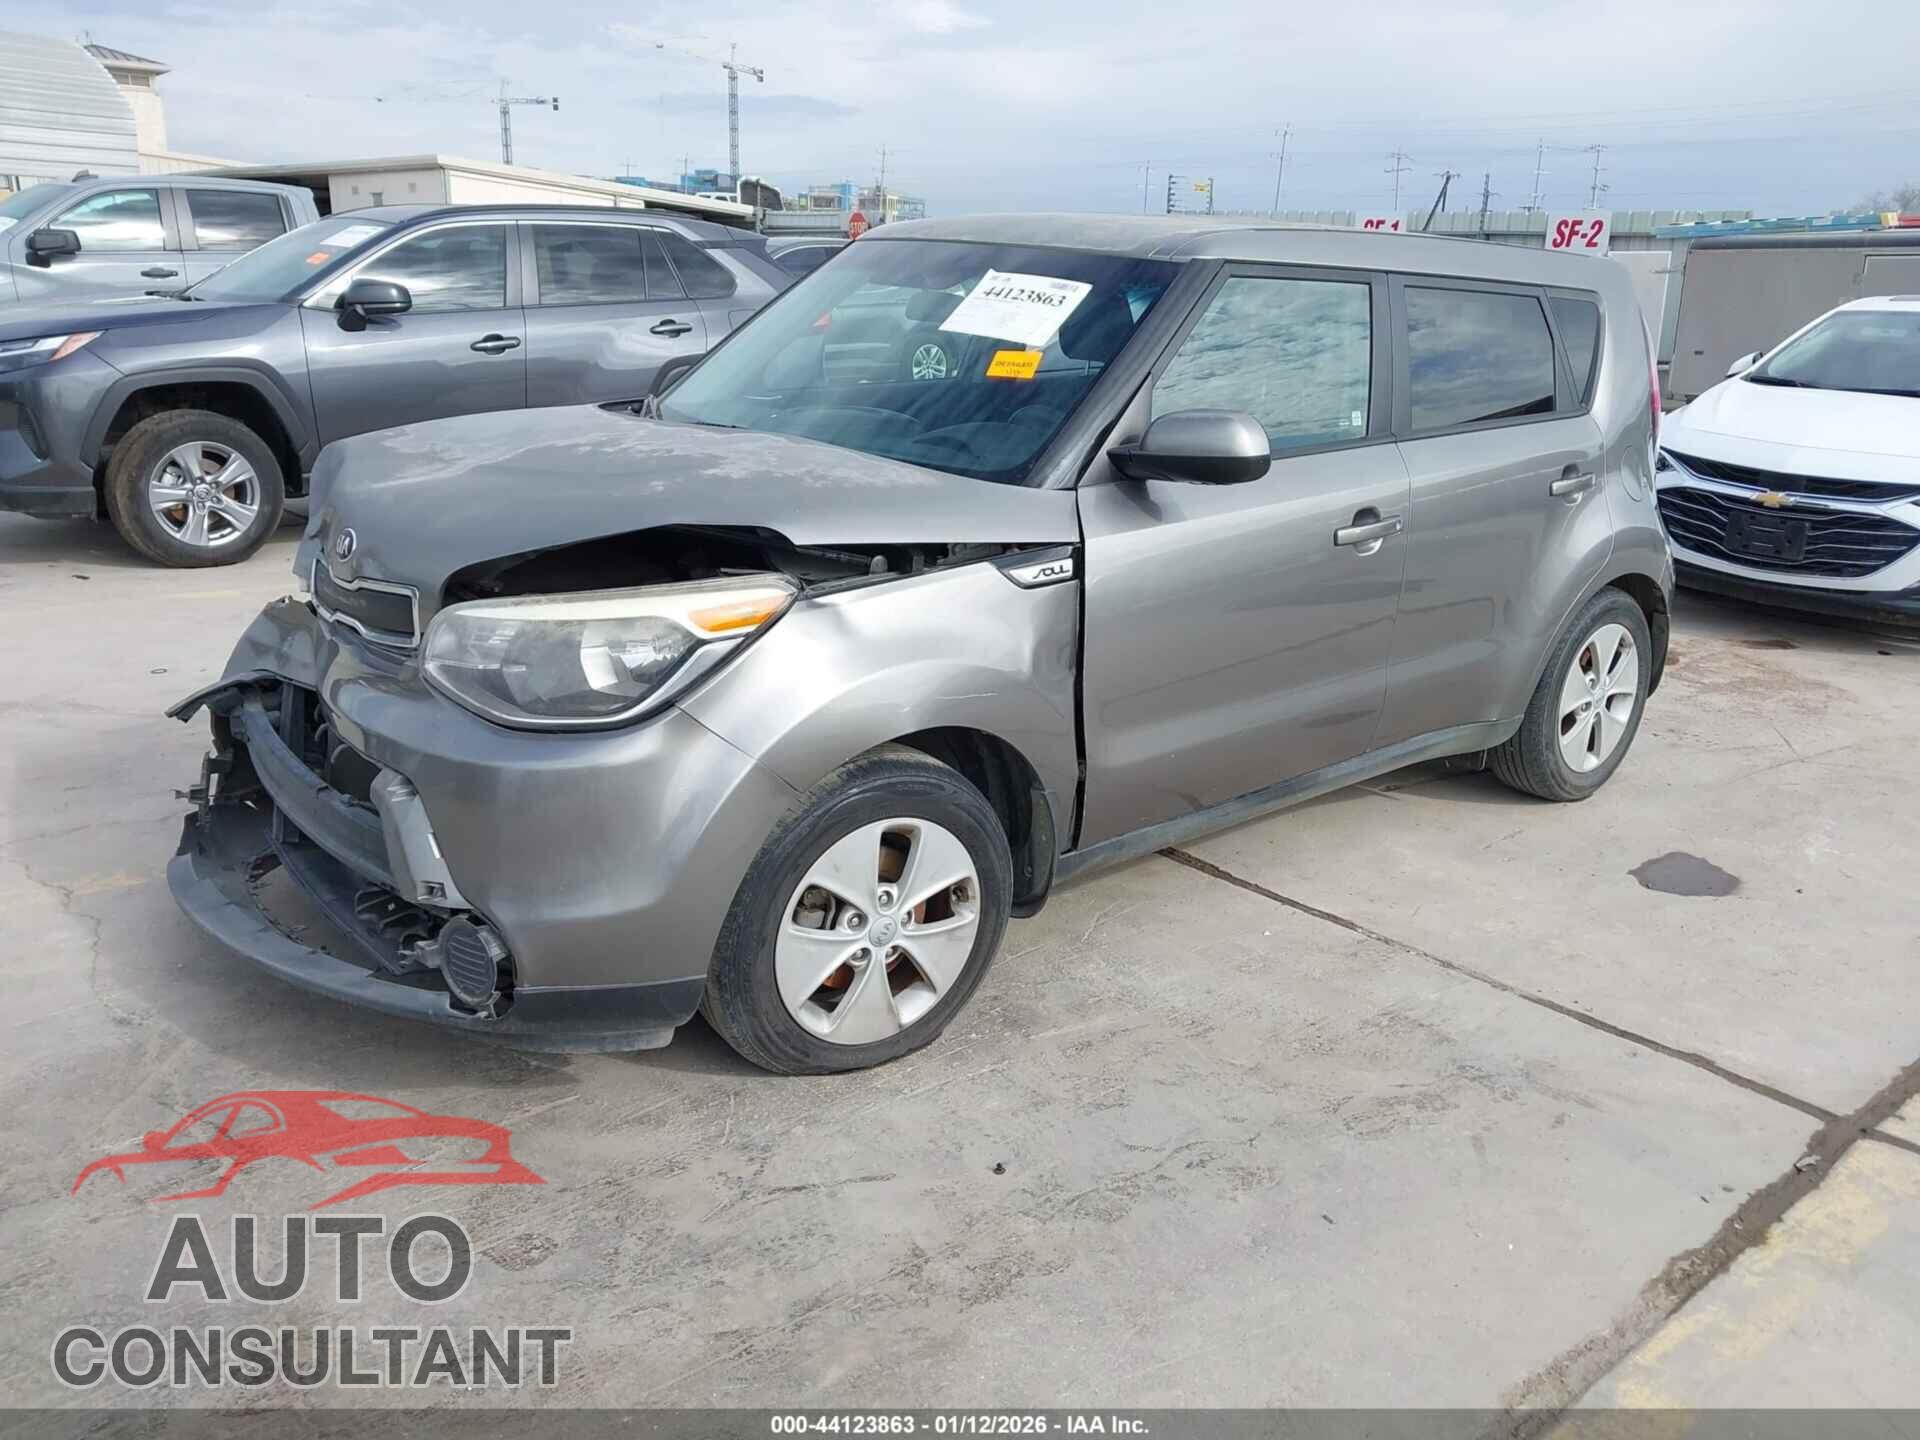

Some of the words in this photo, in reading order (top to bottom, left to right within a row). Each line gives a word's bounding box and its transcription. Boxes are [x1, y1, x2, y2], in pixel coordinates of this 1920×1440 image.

[850, 221, 867, 233] STOP
[1552, 219, 1604, 248] SF-2
[983, 286, 1067, 307] 44123863
